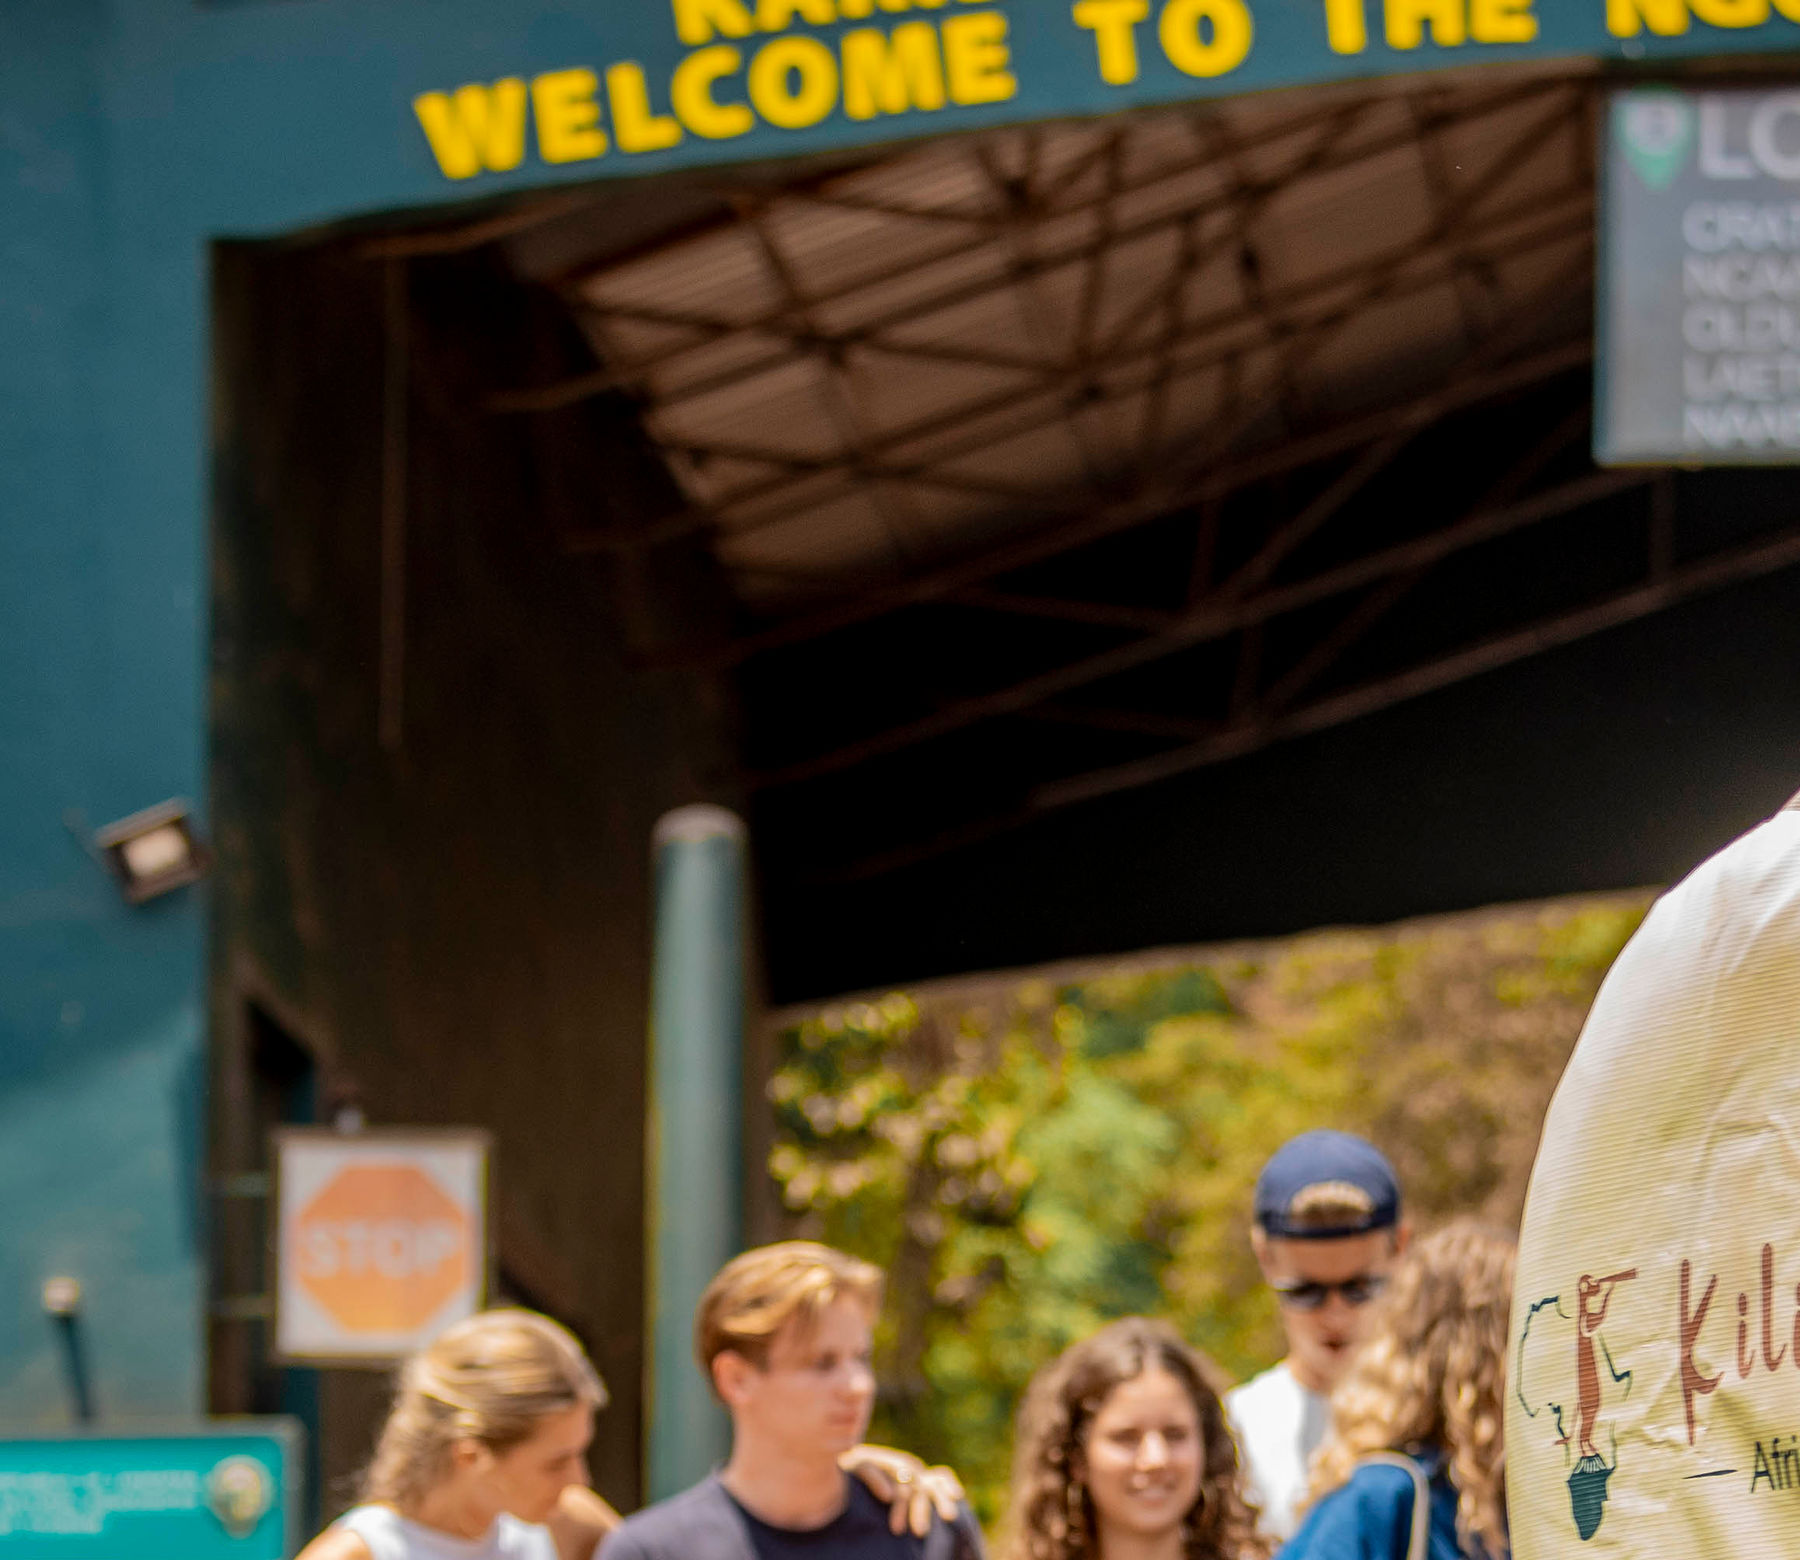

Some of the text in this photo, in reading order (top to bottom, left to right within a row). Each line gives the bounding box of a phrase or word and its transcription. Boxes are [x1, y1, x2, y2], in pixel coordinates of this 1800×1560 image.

[414, 10, 1017, 180] WELCOME
[1073, 0, 1252, 84] TO
[304, 1218, 458, 1279] STOP
